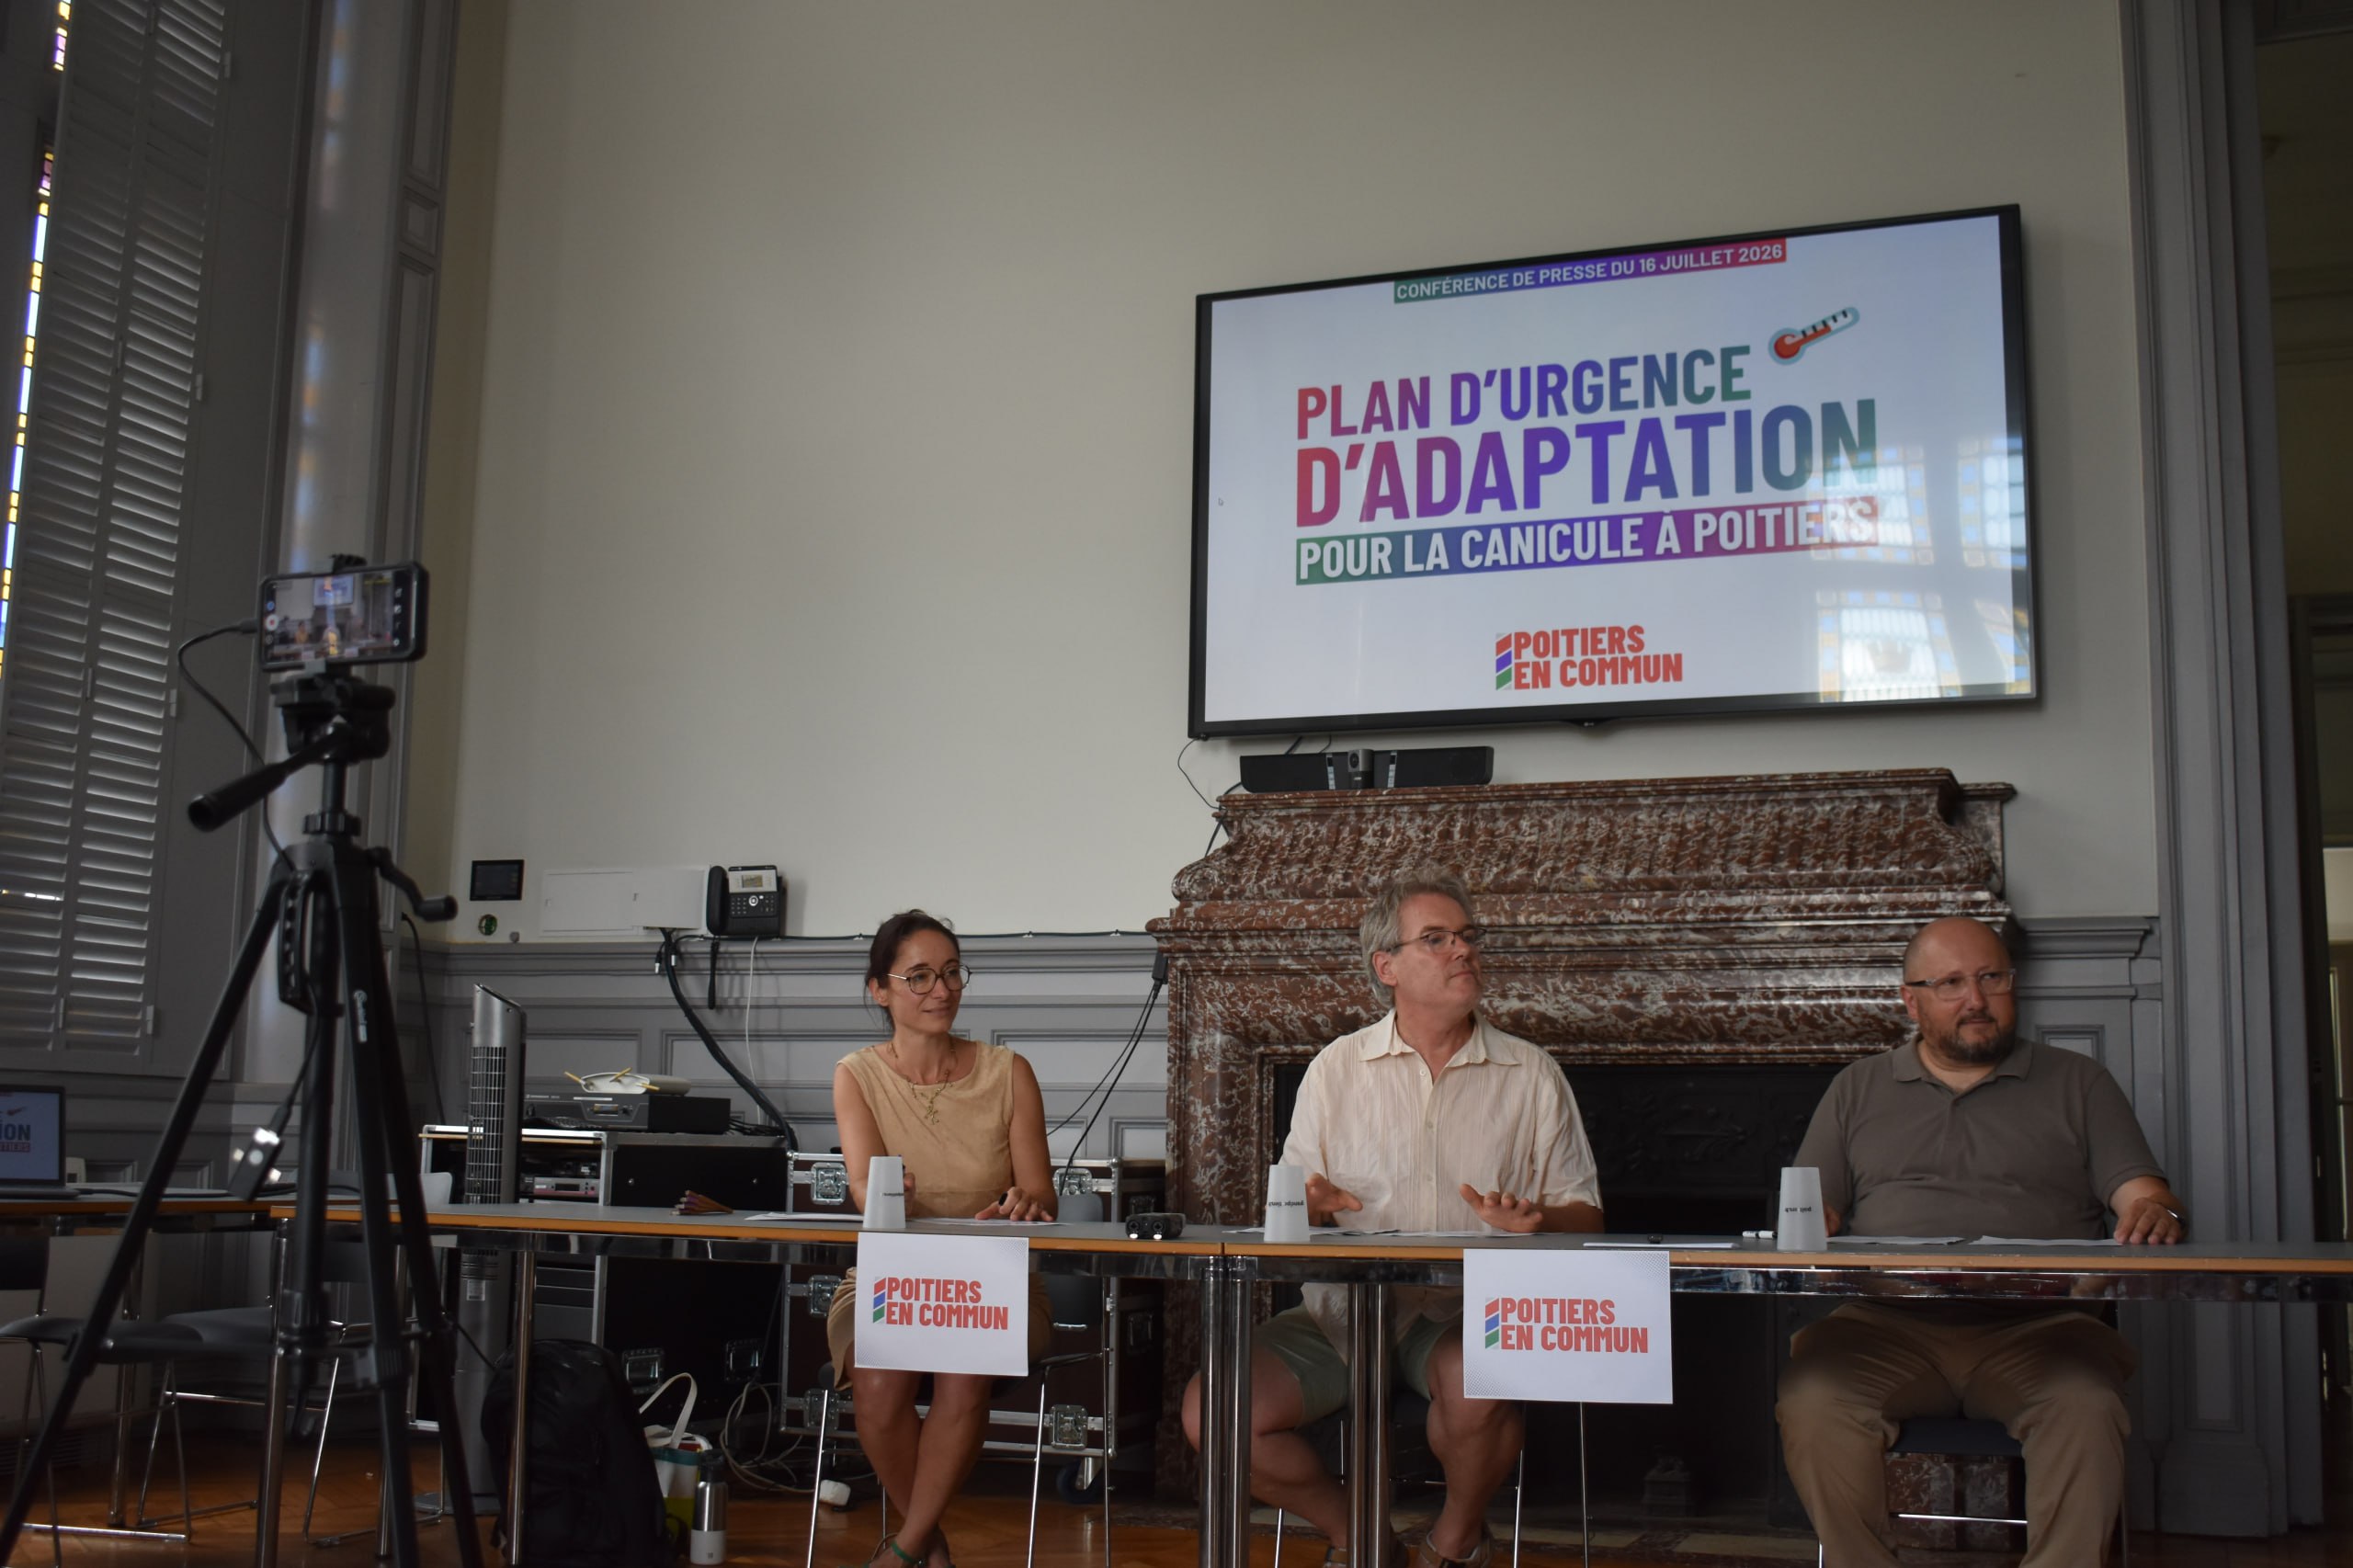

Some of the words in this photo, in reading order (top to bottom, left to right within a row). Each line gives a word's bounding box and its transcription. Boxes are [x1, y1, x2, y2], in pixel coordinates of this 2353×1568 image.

[1396, 276, 1510, 300] CONFÉRENCE
[1512, 272, 1535, 287] DE
[1539, 265, 1608, 285] PRESSE
[1610, 260, 1636, 277] DU
[1639, 257, 1656, 273] 16
[1659, 249, 1734, 271] JUILLET
[1738, 244, 1783, 263] 2026
[1297, 376, 1430, 439] PLAN
[1450, 345, 1752, 426] D'URGENCE
[1296, 398, 1878, 528] D'ADAPTATION
[1299, 536, 1393, 580] POUR
[1404, 532, 1449, 573] LA
[1461, 517, 1644, 569] CANICULE
[1654, 509, 1682, 555] À
[1693, 499, 1873, 552] POITIERS
[1514, 624, 1645, 660] POITIERS
[1514, 660, 1552, 689] EN
[1559, 653, 1683, 687] COMMUN
[886, 1277, 983, 1304] POITIERS
[886, 1301, 914, 1325] EN
[919, 1303, 1008, 1330] COMMUN
[1501, 1297, 1616, 1324] POITIERS
[1501, 1324, 1533, 1350] EN
[1540, 1325, 1648, 1353] COMMUN
